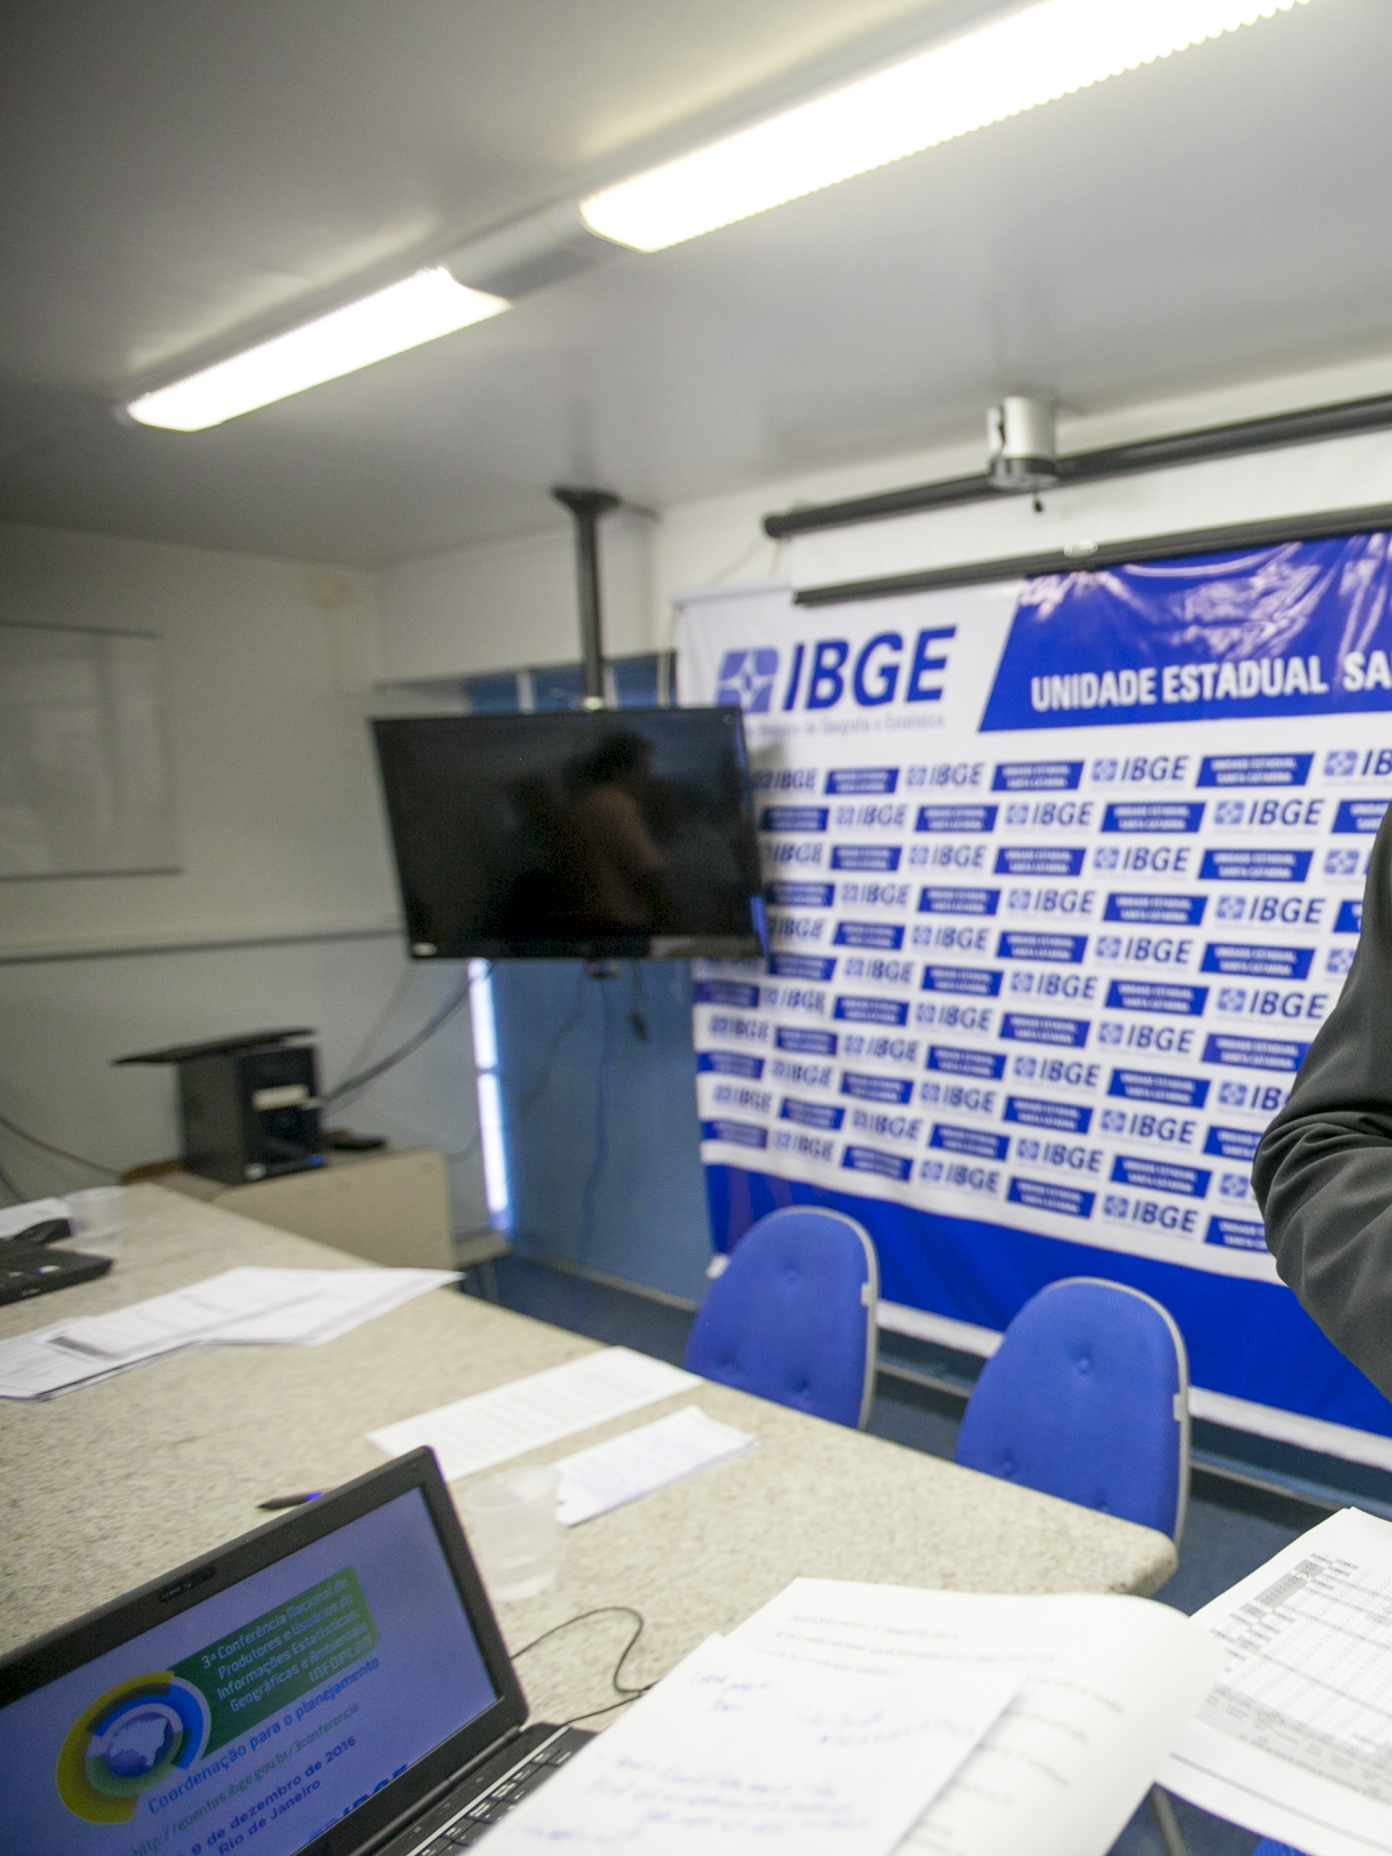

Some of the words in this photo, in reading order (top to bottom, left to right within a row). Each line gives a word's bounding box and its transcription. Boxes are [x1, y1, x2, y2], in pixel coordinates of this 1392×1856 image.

[782, 624, 957, 712] IBGE
[1030, 667, 1158, 712] UNIDADE
[1162, 655, 1328, 704] ESTADUAL
[928, 763, 984, 787] IBGE
[1120, 755, 1190, 782] IBGE
[1031, 801, 1095, 827] IBGE
[1248, 799, 1327, 826] IBGE
[931, 845, 988, 869] IBGE
[1122, 847, 1192, 873] IBGE
[1033, 889, 1097, 914] IBGE
[1249, 896, 1326, 925] IBGE
[934, 926, 991, 950] IBGE
[1124, 937, 1194, 964] IBGE
[1036, 973, 1100, 1000] IBGE
[938, 1007, 994, 1033] IBGE
[1249, 990, 1329, 1020] IBGE
[1127, 1025, 1196, 1053] IBGE
[1038, 1058, 1101, 1089] IBGE
[942, 1085, 999, 1114] IBGE
[1129, 1112, 1197, 1145] IBGE
[1042, 1140, 1104, 1174] IBGE
[946, 1163, 1001, 1194] IBGE
[1132, 1199, 1199, 1233] IBGE
[218, 1614, 288, 1660] Conferência
[218, 1636, 282, 1680] Produtores
[283, 1631, 292, 1641] e
[216, 1650, 290, 1700] Informações
[229, 1664, 300, 1712] Geográficas
[301, 1659, 310, 1670] e
[148, 1743, 247, 1815] Coordenação
[250, 1722, 282, 1751] para
[284, 1715, 292, 1726] o
[295, 1656, 380, 1722] planejamento
[207, 1828, 226, 1847] de
[230, 1776, 302, 1829] dezembro
[304, 1760, 322, 1777] de
[325, 1736, 358, 1764] 2016
[219, 1833, 244, 1856] Rio
[247, 1817, 267, 1835] de
[271, 1780, 322, 1820] Janeiro
